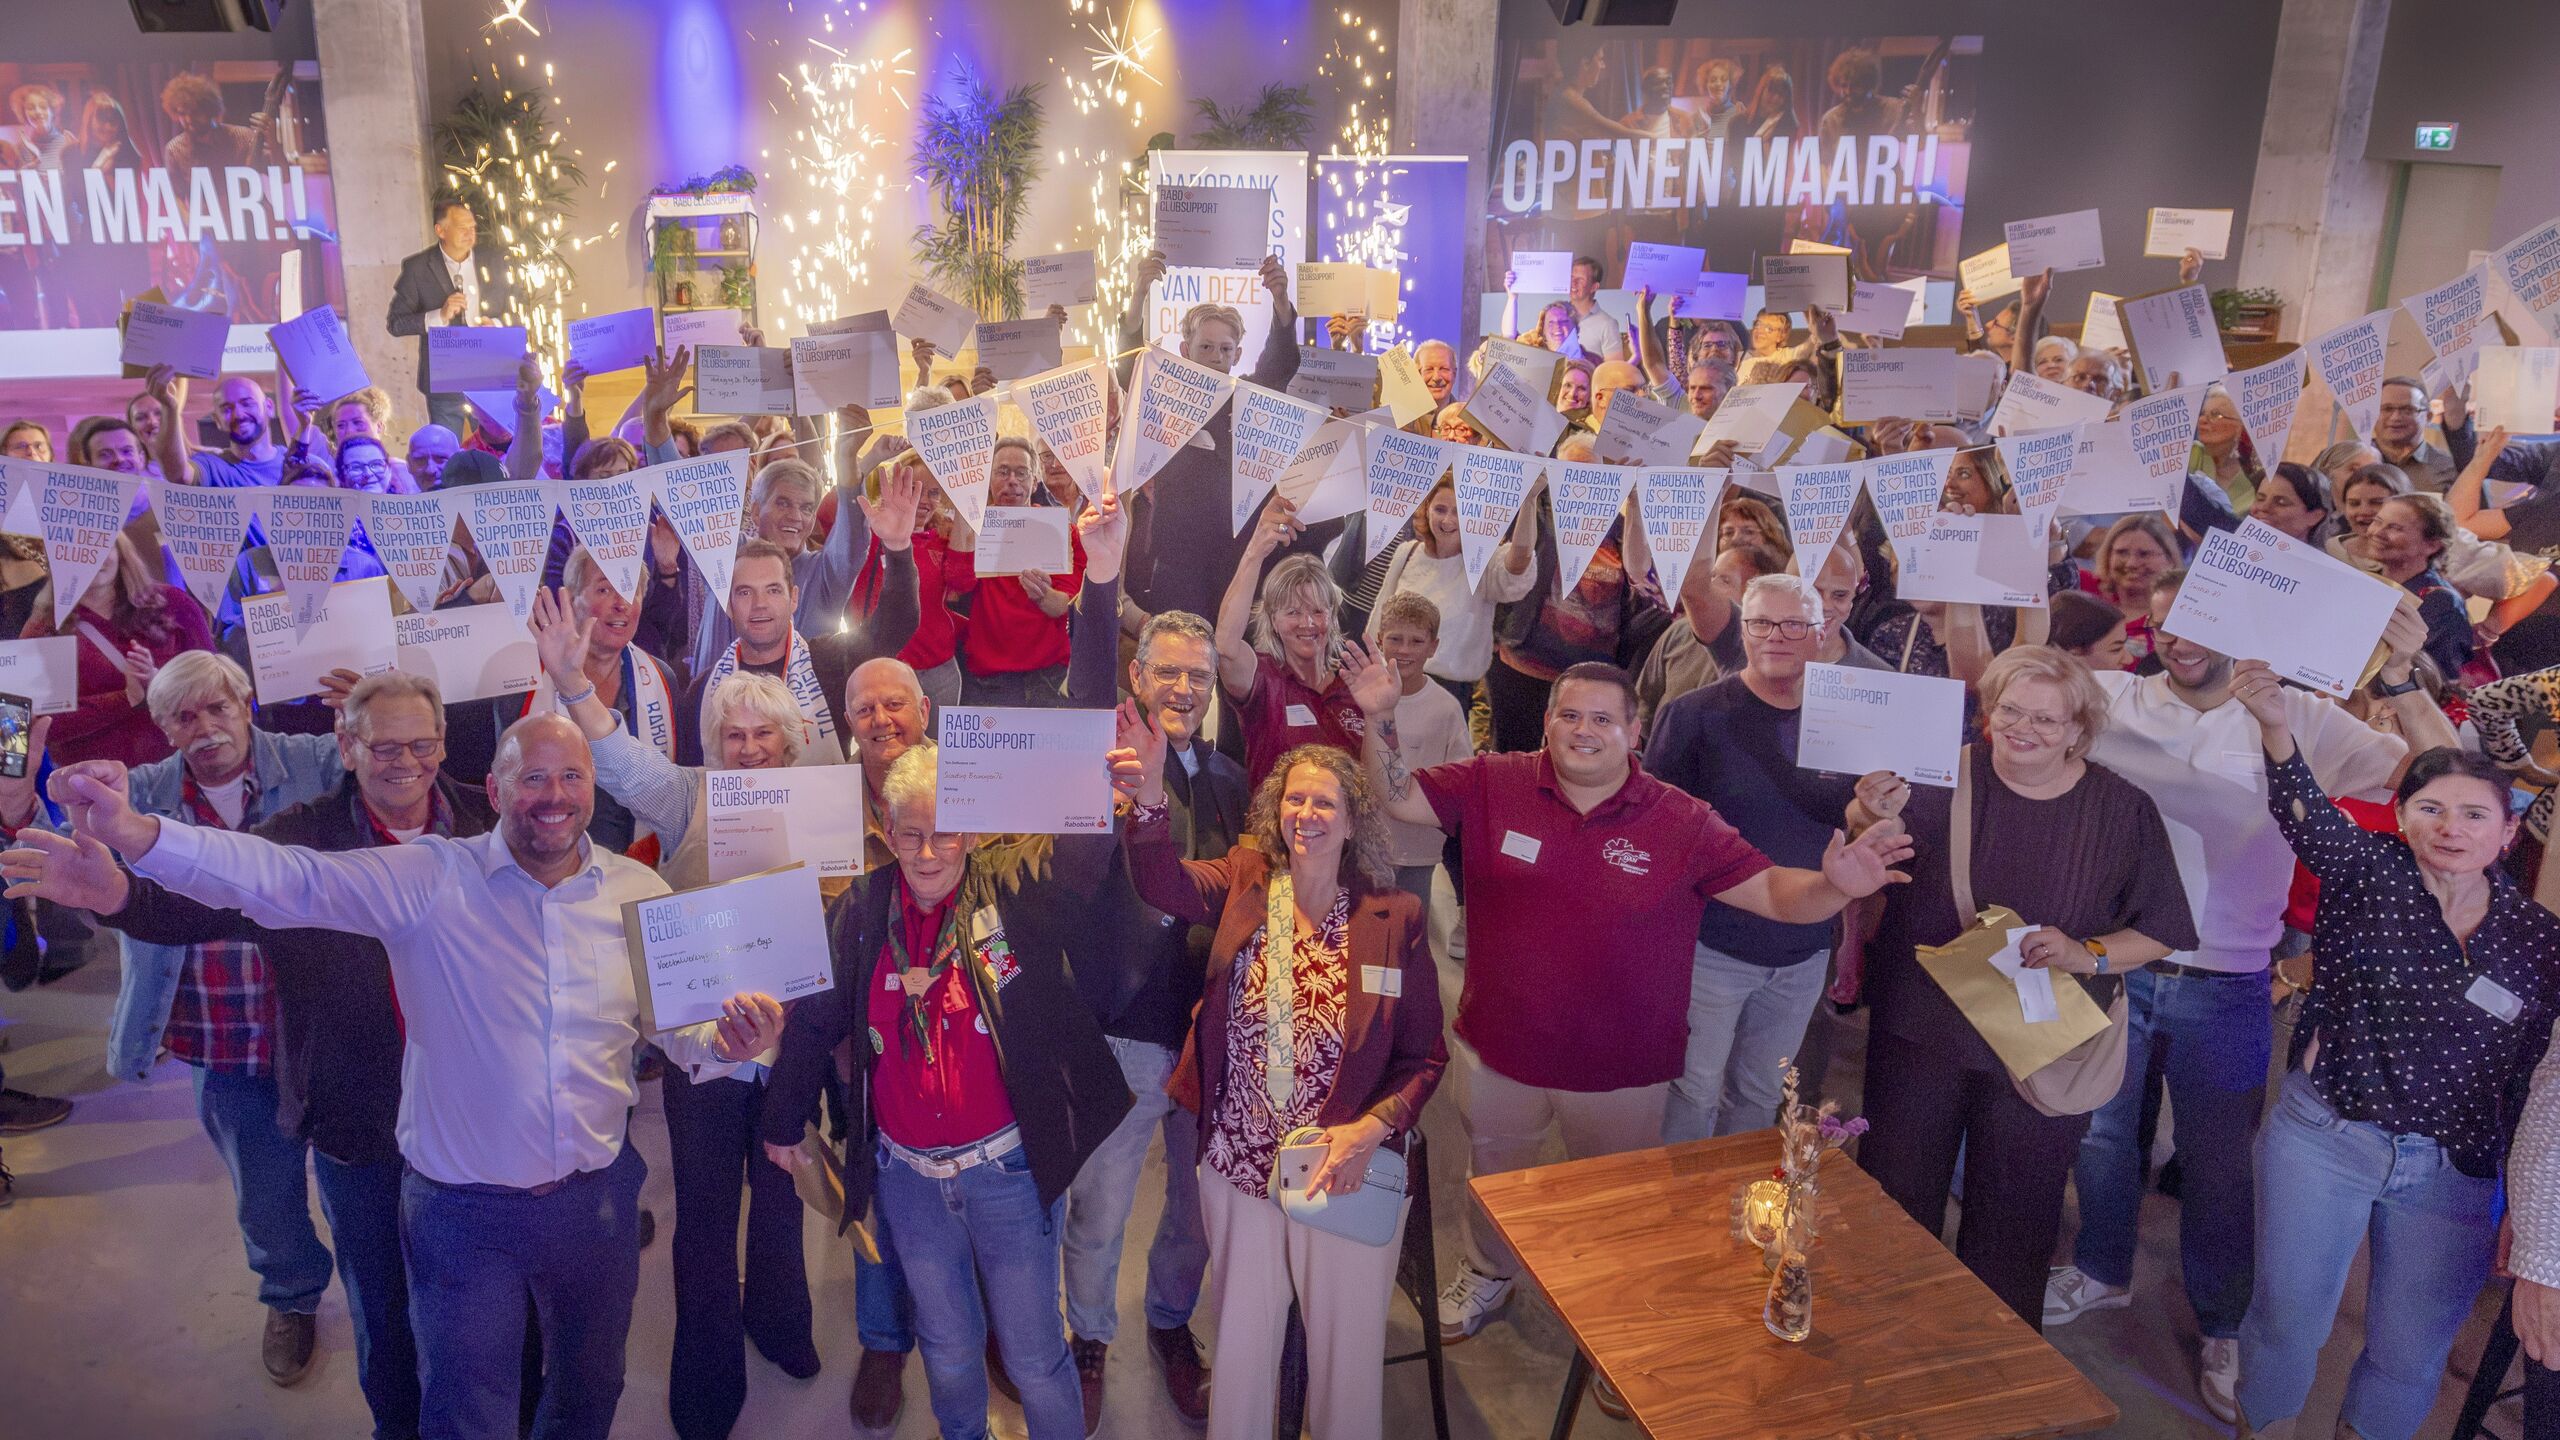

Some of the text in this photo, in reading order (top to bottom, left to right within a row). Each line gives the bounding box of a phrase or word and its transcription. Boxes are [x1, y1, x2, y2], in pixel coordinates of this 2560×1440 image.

[1501, 133, 1940, 213] OPENEN MAAR!!
[82, 164, 311, 244] MAAR!!
[1160, 189, 1184, 201] RABO
[1159, 200, 1219, 214] CLUBSUPPORT
[2009, 226, 2056, 242] CLUBSUPPORT
[1298, 272, 1335, 282] CLUBSUPPORT
[1161, 274, 1262, 305] VAN DEZE
[2425, 273, 2479, 309] RABOBANK
[2425, 287, 2481, 323] IS TROTS
[2426, 300, 2482, 336] SUPPORTER
[978, 325, 996, 336] RABO
[979, 331, 1022, 344] CLUBSUPPORT
[2433, 315, 2478, 347] VAN DEZE
[701, 349, 721, 360] RABO
[795, 341, 818, 353] RABO
[796, 348, 852, 364] CLUBSUPPORT
[2441, 335, 2473, 357] CLUBS
[701, 358, 750, 370] CLUBSUPPORT
[1847, 352, 1869, 363] RABO
[1847, 361, 1904, 373] CLUBSUPPORT
[1158, 358, 1221, 393] RABOBANK
[1498, 364, 1515, 382] RABO
[2014, 374, 2035, 390] RABO
[2243, 359, 2297, 389] RABOBANK
[1150, 373, 1216, 408] IS TROTS
[1492, 373, 1532, 408] CLUBSUPPORT
[2009, 383, 2061, 407] CLUBSUPPORT
[2242, 373, 2300, 401] IS TROTS
[1143, 388, 1208, 424] SUPPORTER
[1615, 391, 1636, 406] RABO
[2242, 387, 2300, 418] SUPPORTER
[919, 403, 984, 432] RABOBANK
[1142, 405, 1197, 437] VAN DEZE
[1611, 400, 1662, 426] CLUBSUPPORT
[2249, 402, 2296, 429] VAN DEZE
[922, 420, 989, 446] IS TROTS
[1143, 423, 1181, 448] CLUBS
[2256, 418, 2288, 440] CLUBS
[924, 435, 993, 463] SUPPORTER
[1382, 434, 1442, 461] RABOBANK
[2019, 431, 2074, 455] RABOBANK
[934, 450, 991, 477] VAN DEZE
[1375, 450, 1438, 476] IS TROTS
[2016, 444, 2074, 470] IS TROTS
[947, 468, 985, 490] CLUBS
[1369, 465, 1433, 492] SUPPORTER
[1795, 470, 1851, 486] RABOBANK
[2015, 462, 2073, 484] SUPPORTER
[569, 480, 637, 502] RABOBANK
[1370, 481, 1423, 505] VAN DEZE
[1791, 485, 1851, 501] IS TROTS
[2019, 473, 2066, 497] VAN DEZE
[165, 490, 236, 510] RABOBANK
[371, 498, 441, 515] RABOBANK
[571, 496, 642, 517] IS TROTS
[1372, 498, 1408, 518] CLUBS
[1789, 501, 1850, 517] SUPPORTER
[2026, 491, 2057, 508] CLUBS
[164, 507, 240, 526] IS TROTS
[372, 514, 445, 531] IS TROTS
[575, 512, 646, 534] SUPPORTER
[984, 509, 997, 518] ABO
[1793, 515, 1843, 531] VAN DEZE
[165, 523, 241, 543] SUPPORTER
[983, 519, 1026, 529] LUBSUPPORT
[374, 530, 448, 547] SUPPORTER
[584, 527, 644, 547] VAN DEZE
[1798, 531, 1833, 545] CLUBS
[1931, 529, 1980, 543] SUPPORT
[2242, 523, 2278, 548] RABO
[172, 540, 235, 558] VAN DEZE
[383, 547, 445, 562] VAN DEZE
[598, 544, 638, 560] CLUBS
[2208, 534, 2248, 560] RABO
[183, 557, 226, 573] CLUBS
[395, 562, 437, 577] CLUBS
[2201, 550, 2301, 596] CLUBSUPPORT
[249, 602, 281, 621] RABO
[396, 617, 425, 633] RABO
[397, 624, 471, 647] CLUBSUPPORT
[1810, 668, 1841, 685] RABO
[1809, 683, 1891, 706] CLUBSUPPORT
[646, 699, 669, 748] RABO
[945, 714, 980, 731] RABO
[945, 731, 1036, 750] CLUBSUPPORT
[712, 776, 742, 792] RABO
[712, 789, 790, 807] CLUBSUPPORT
[1064, 820, 1096, 828] Rabobank
[820, 864, 848, 872] Rabobank
[646, 902, 682, 926] RABO
[785, 982, 816, 994] Rabobank
